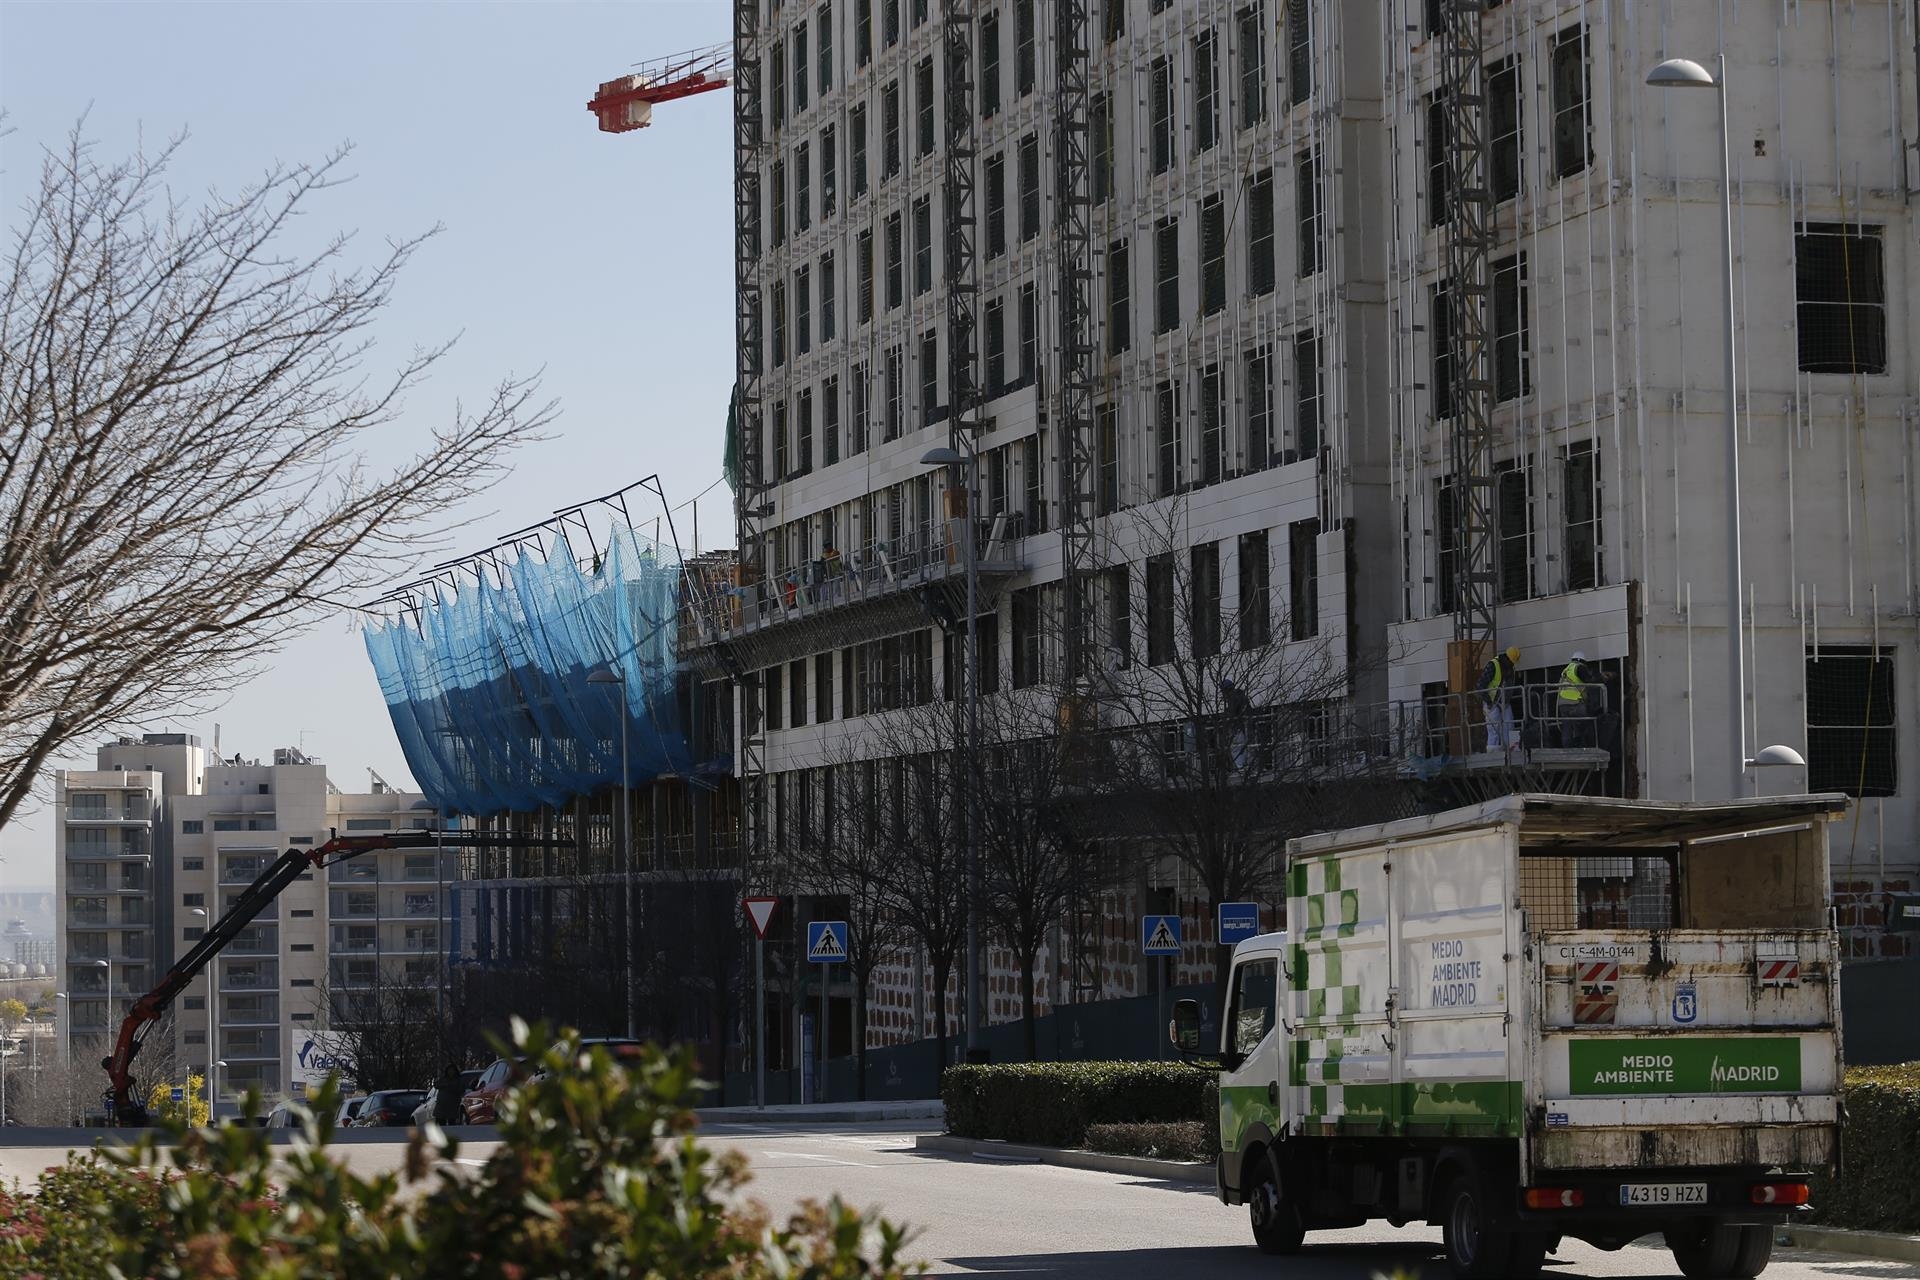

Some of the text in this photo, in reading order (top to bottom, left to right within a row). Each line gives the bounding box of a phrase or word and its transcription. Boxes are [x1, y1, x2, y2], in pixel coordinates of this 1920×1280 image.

[1432, 940, 1463, 959] MEDIO
[1432, 961, 1481, 981] AMBIENTE
[1432, 983, 1476, 1006] MADRID
[1622, 1055, 1673, 1068] MEDIO
[1710, 1056, 1779, 1081] MADRID
[1594, 1070, 1674, 1083] AMBIENTE
[1630, 1186, 1704, 1202] 4319 HZX
